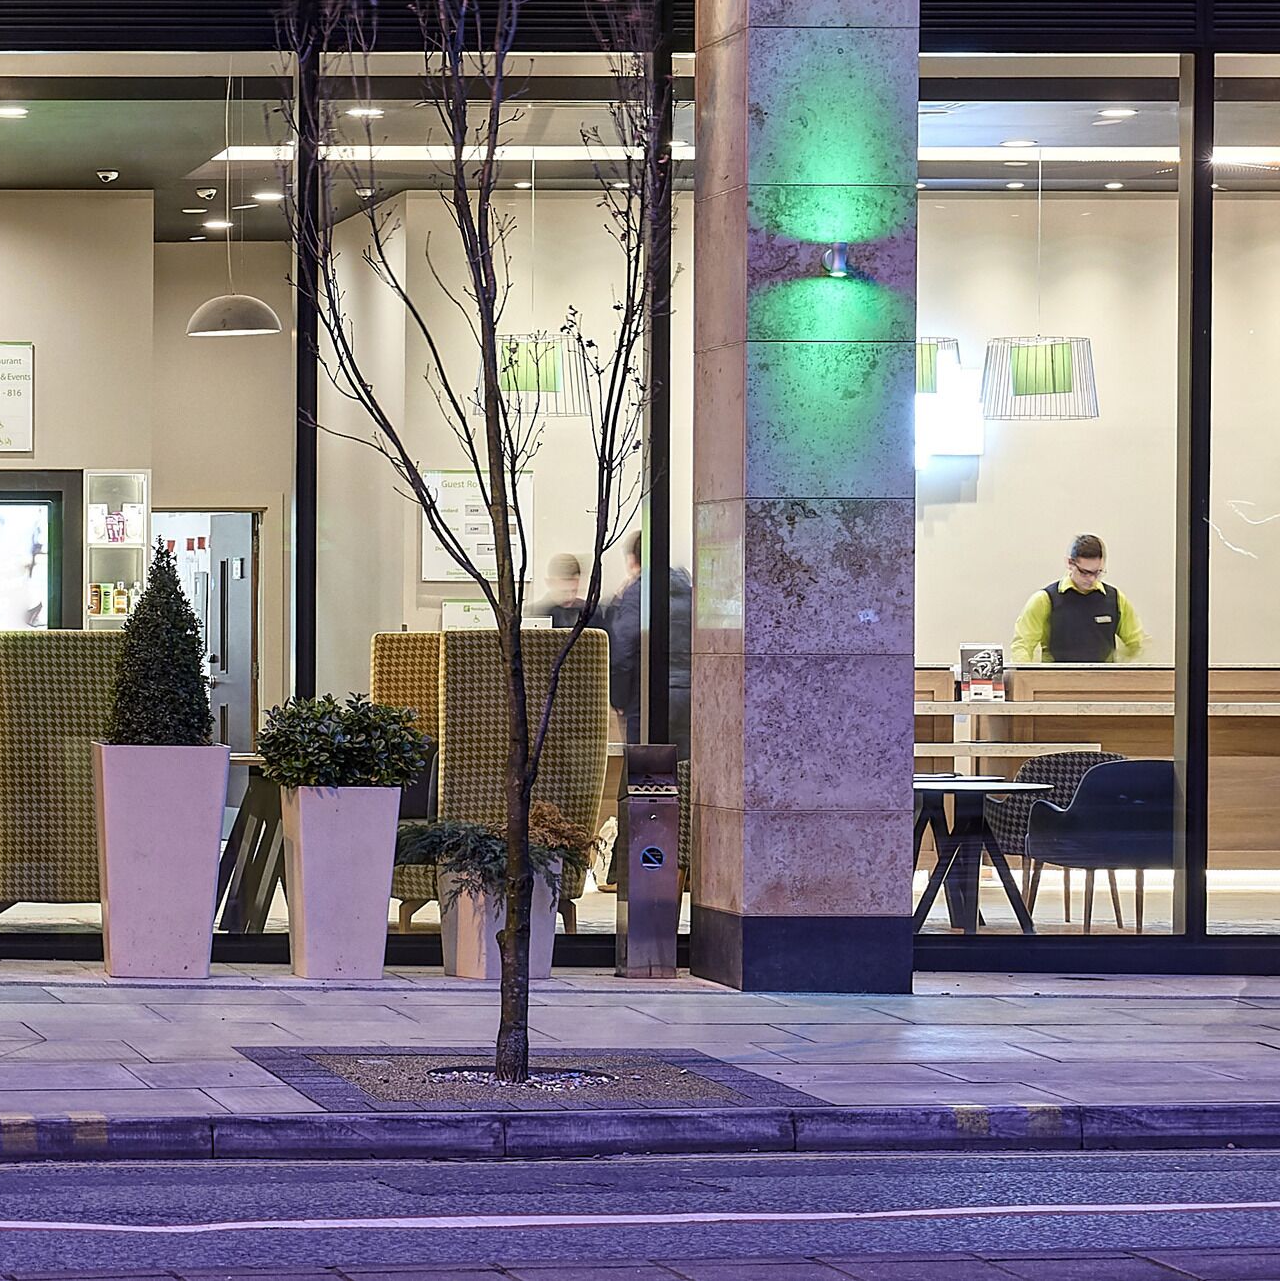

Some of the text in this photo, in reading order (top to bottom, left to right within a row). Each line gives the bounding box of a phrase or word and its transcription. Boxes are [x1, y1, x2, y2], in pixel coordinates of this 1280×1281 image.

[7, 373, 31, 381] Events
[7, 389, 22, 397] 816
[441, 480, 464, 488] Guest
